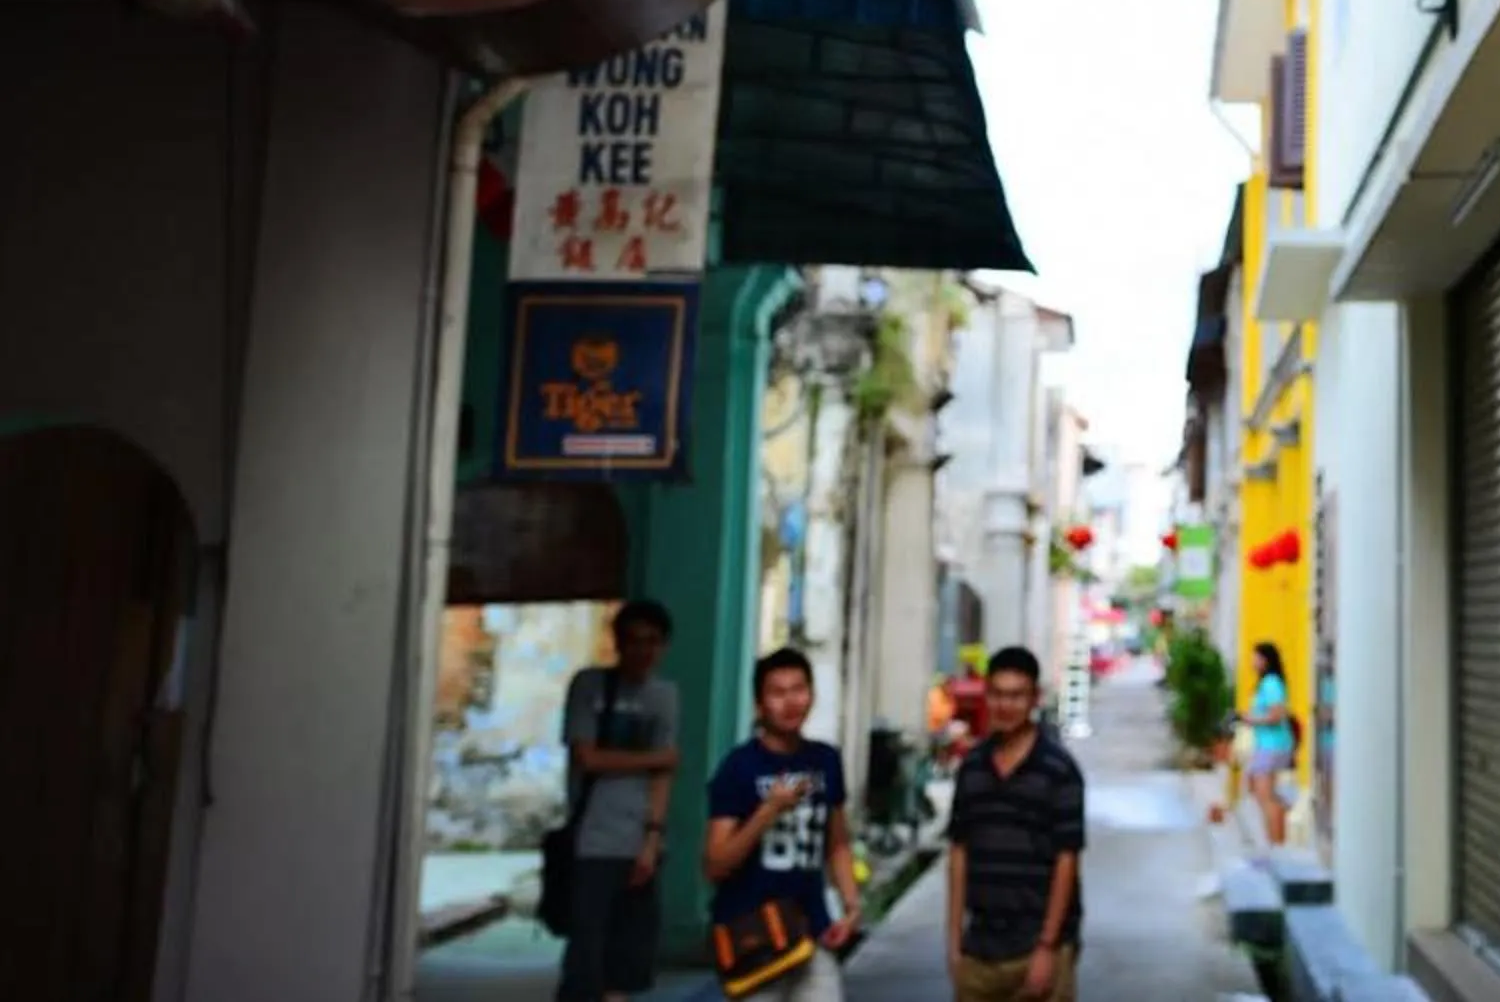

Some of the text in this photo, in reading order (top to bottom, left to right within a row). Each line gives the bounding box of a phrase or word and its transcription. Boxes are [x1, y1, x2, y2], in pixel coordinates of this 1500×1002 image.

[578, 94, 660, 136] KOH
[579, 143, 653, 184] KEE
[540, 382, 641, 432] Tiger
